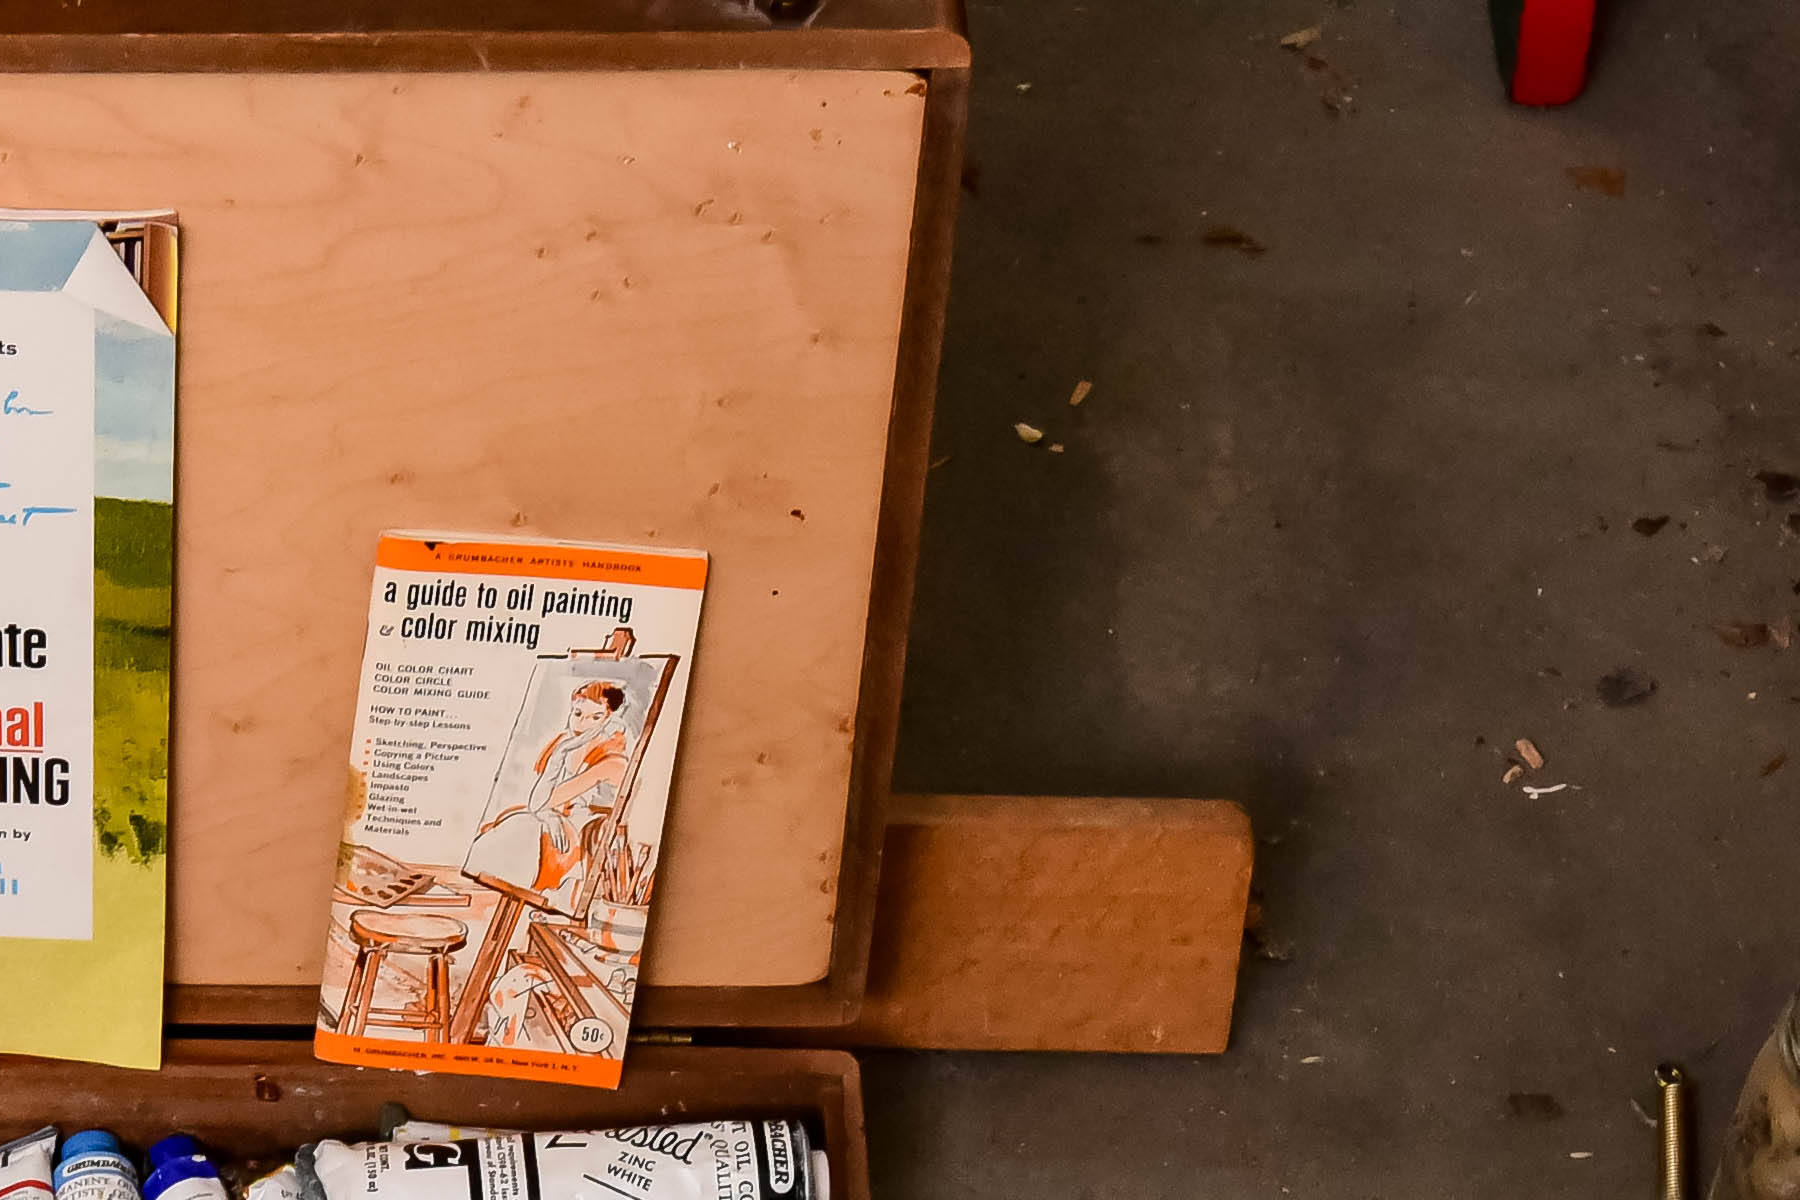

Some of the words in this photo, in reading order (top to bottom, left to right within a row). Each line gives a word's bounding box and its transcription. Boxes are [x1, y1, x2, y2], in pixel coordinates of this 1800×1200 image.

[581, 561, 642, 573] HANDBOOK
[384, 581, 398, 603] a
[406, 579, 468, 611] guide
[477, 582, 498, 609] to
[506, 583, 535, 611] oil
[541, 587, 634, 624] painting
[401, 612, 458, 640] color
[465, 615, 541, 650] mixing
[375, 662, 391, 672] OIL
[397, 664, 434, 674] COLOR
[438, 666, 475, 676] CHART
[374, 673, 411, 684] COLOR
[415, 676, 453, 687] CIRCLE
[372, 684, 409, 696] COLOR
[413, 688, 452, 698] MIXING
[457, 690, 491, 700] GUIDE
[370, 704, 396, 715] HOW
[399, 707, 412, 717] TO
[432, 720, 471, 731] Lessons
[430, 741, 487, 752] Perspective
[373, 749, 414, 760] Copying
[424, 752, 460, 761] Picture
[372, 760, 401, 771] Using
[403, 761, 435, 772] Colors
[371, 770, 429, 782] Landscapes
[370, 781, 410, 792] Impasto
[368, 792, 405, 804] Glazing
[367, 813, 421, 826] Techniques
[423, 818, 443, 827] and
[12, 827, 32, 842] by
[364, 825, 410, 836] Materials
[618, 1151, 657, 1172] ZINC
[734, 1140, 752, 1171] OIL
[508, 1141, 519, 1196] requirements
[607, 1163, 653, 1192] WHITE
